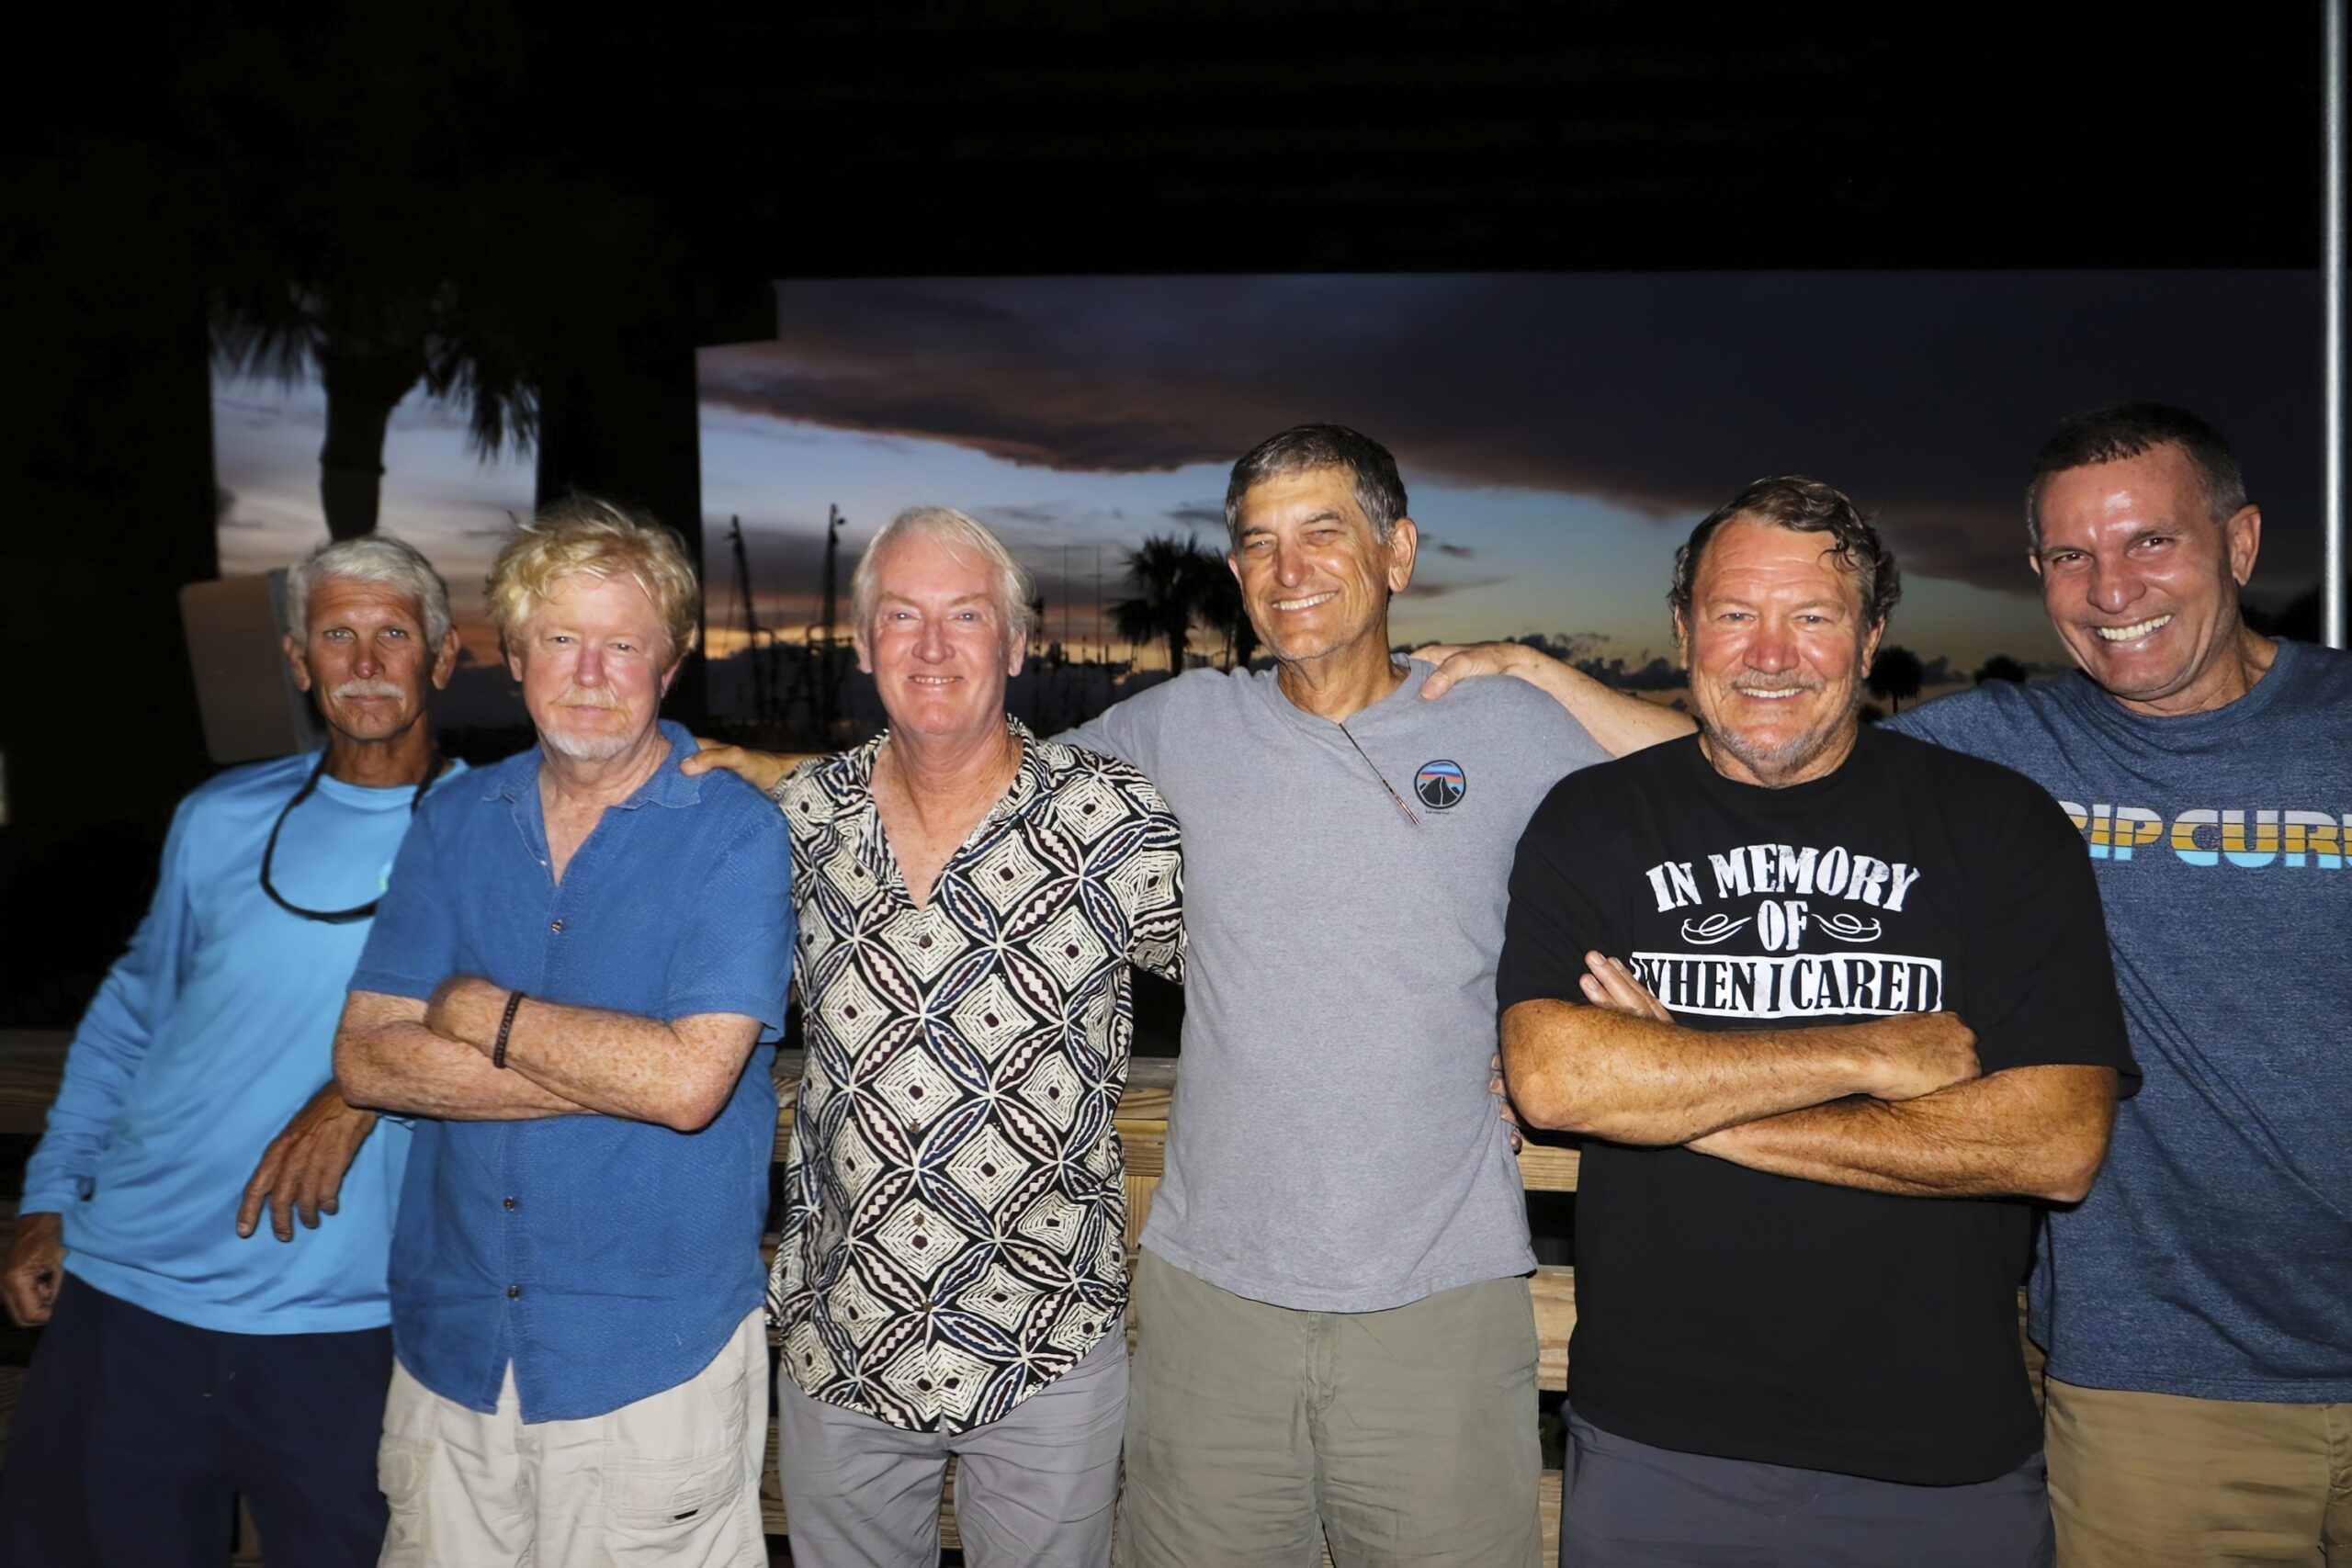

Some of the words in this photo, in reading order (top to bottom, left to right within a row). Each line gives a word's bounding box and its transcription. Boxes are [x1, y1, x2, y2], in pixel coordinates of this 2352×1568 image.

[2170, 808, 2352, 869] CUR
[1645, 861, 1702, 912] IN
[1707, 843, 1921, 912] MEMORY
[1757, 899, 1808, 952] OF
[1630, 957, 1757, 1011] WHEN
[1766, 963, 1784, 1012] I
[1790, 958, 1941, 1012] CARED
